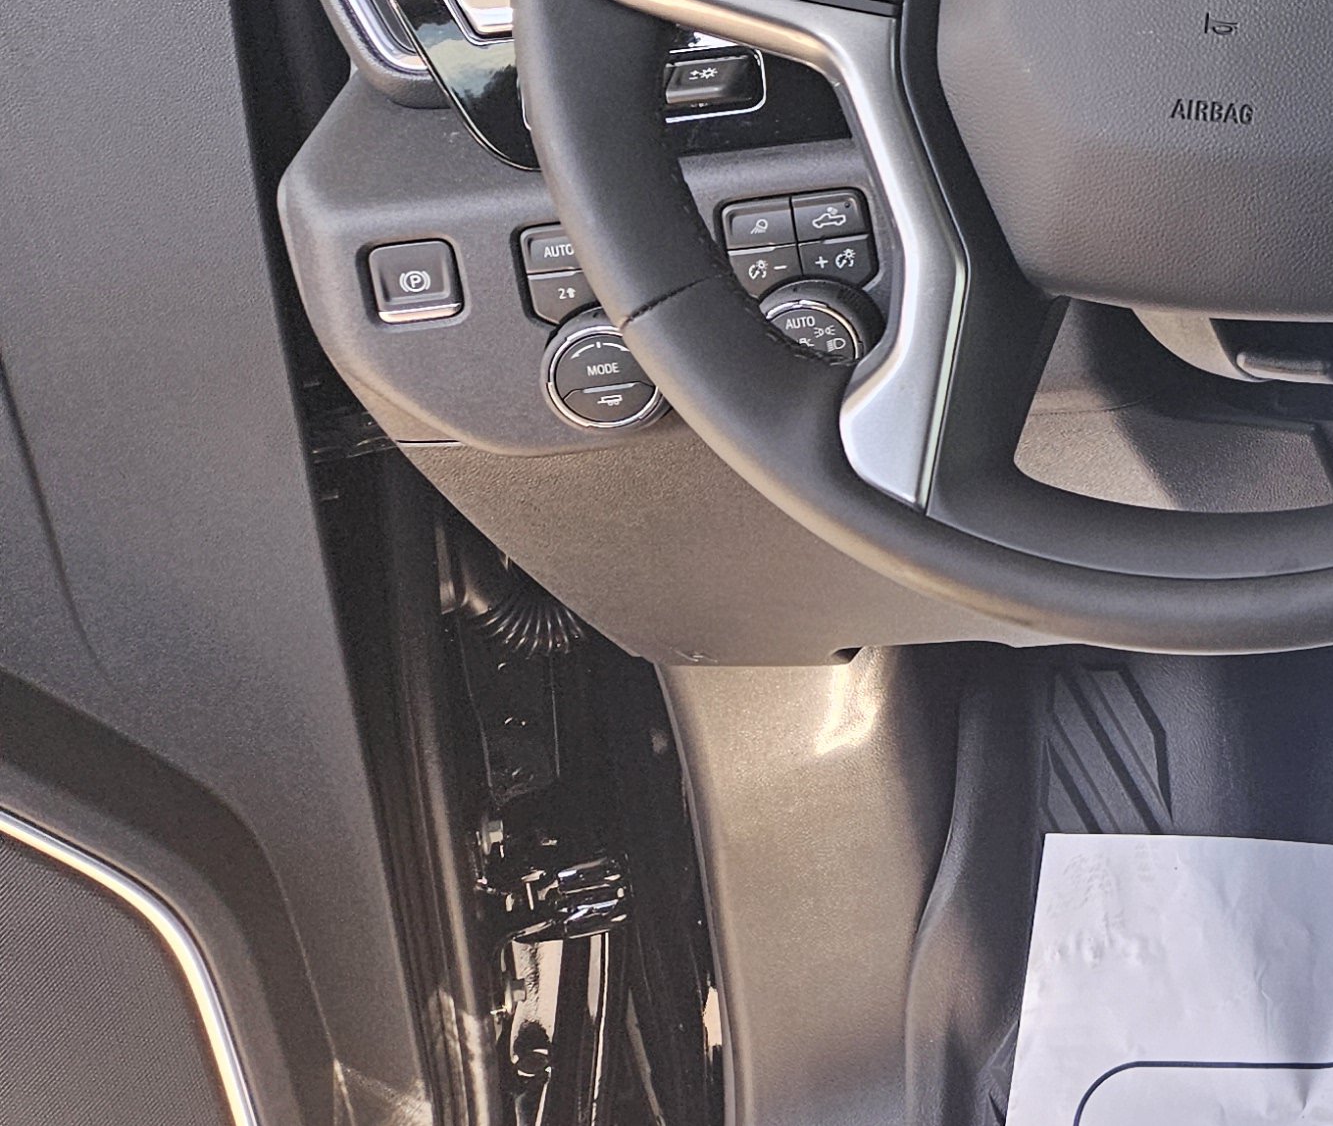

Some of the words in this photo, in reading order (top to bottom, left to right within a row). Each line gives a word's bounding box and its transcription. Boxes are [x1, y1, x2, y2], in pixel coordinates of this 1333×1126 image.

[1170, 98, 1253, 124] AIRBAG
[543, 243, 575, 258] AUTO
[785, 315, 816, 330] AUTO
[586, 362, 620, 376] MODE
